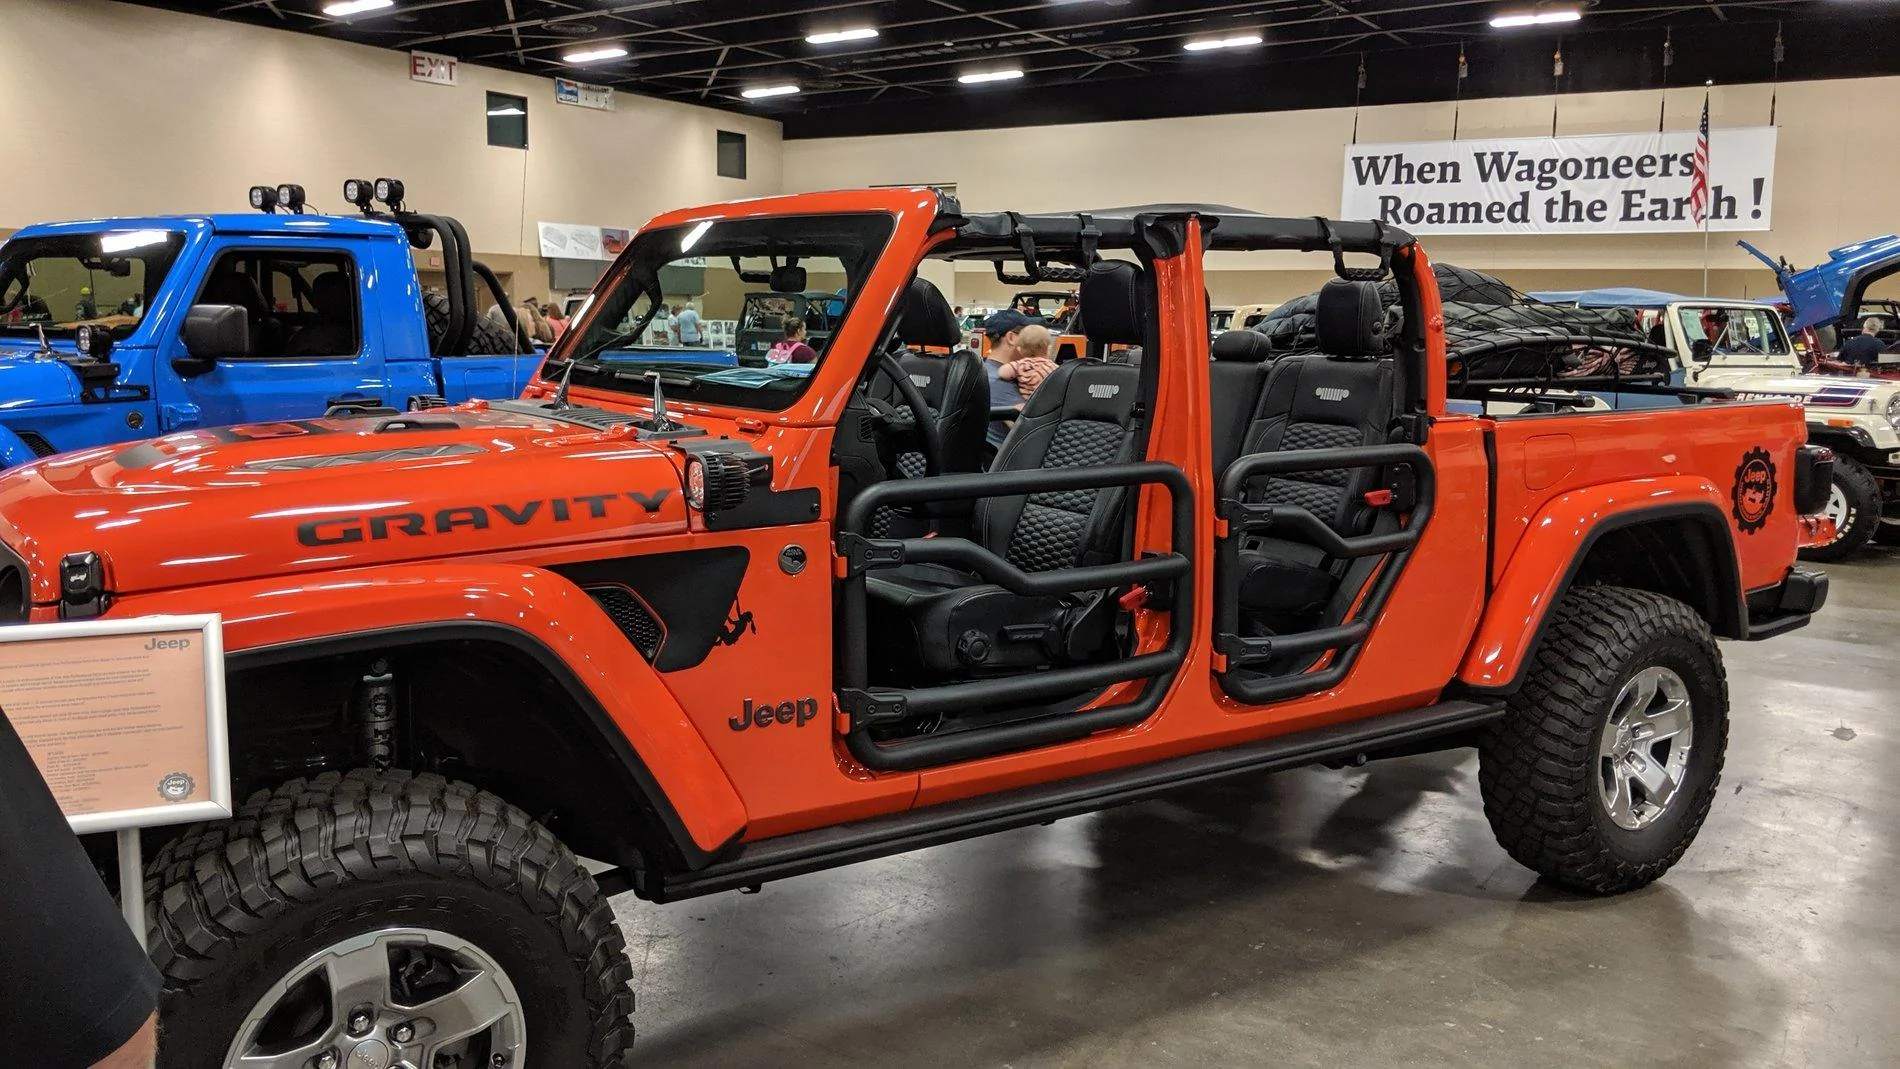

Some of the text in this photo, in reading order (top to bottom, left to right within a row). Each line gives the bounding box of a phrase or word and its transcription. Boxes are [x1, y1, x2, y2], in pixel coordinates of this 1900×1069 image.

[1352, 151, 1695, 191] When Wagoneers
[1378, 190, 1530, 225] Roamed
[1544, 189, 1608, 223] the
[1619, 184, 1738, 223] Earh
[1744, 468, 1766, 484] Jeep
[296, 489, 673, 548] GRAVITY
[144, 637, 191, 651] Jeep
[728, 697, 818, 732] Jeep
